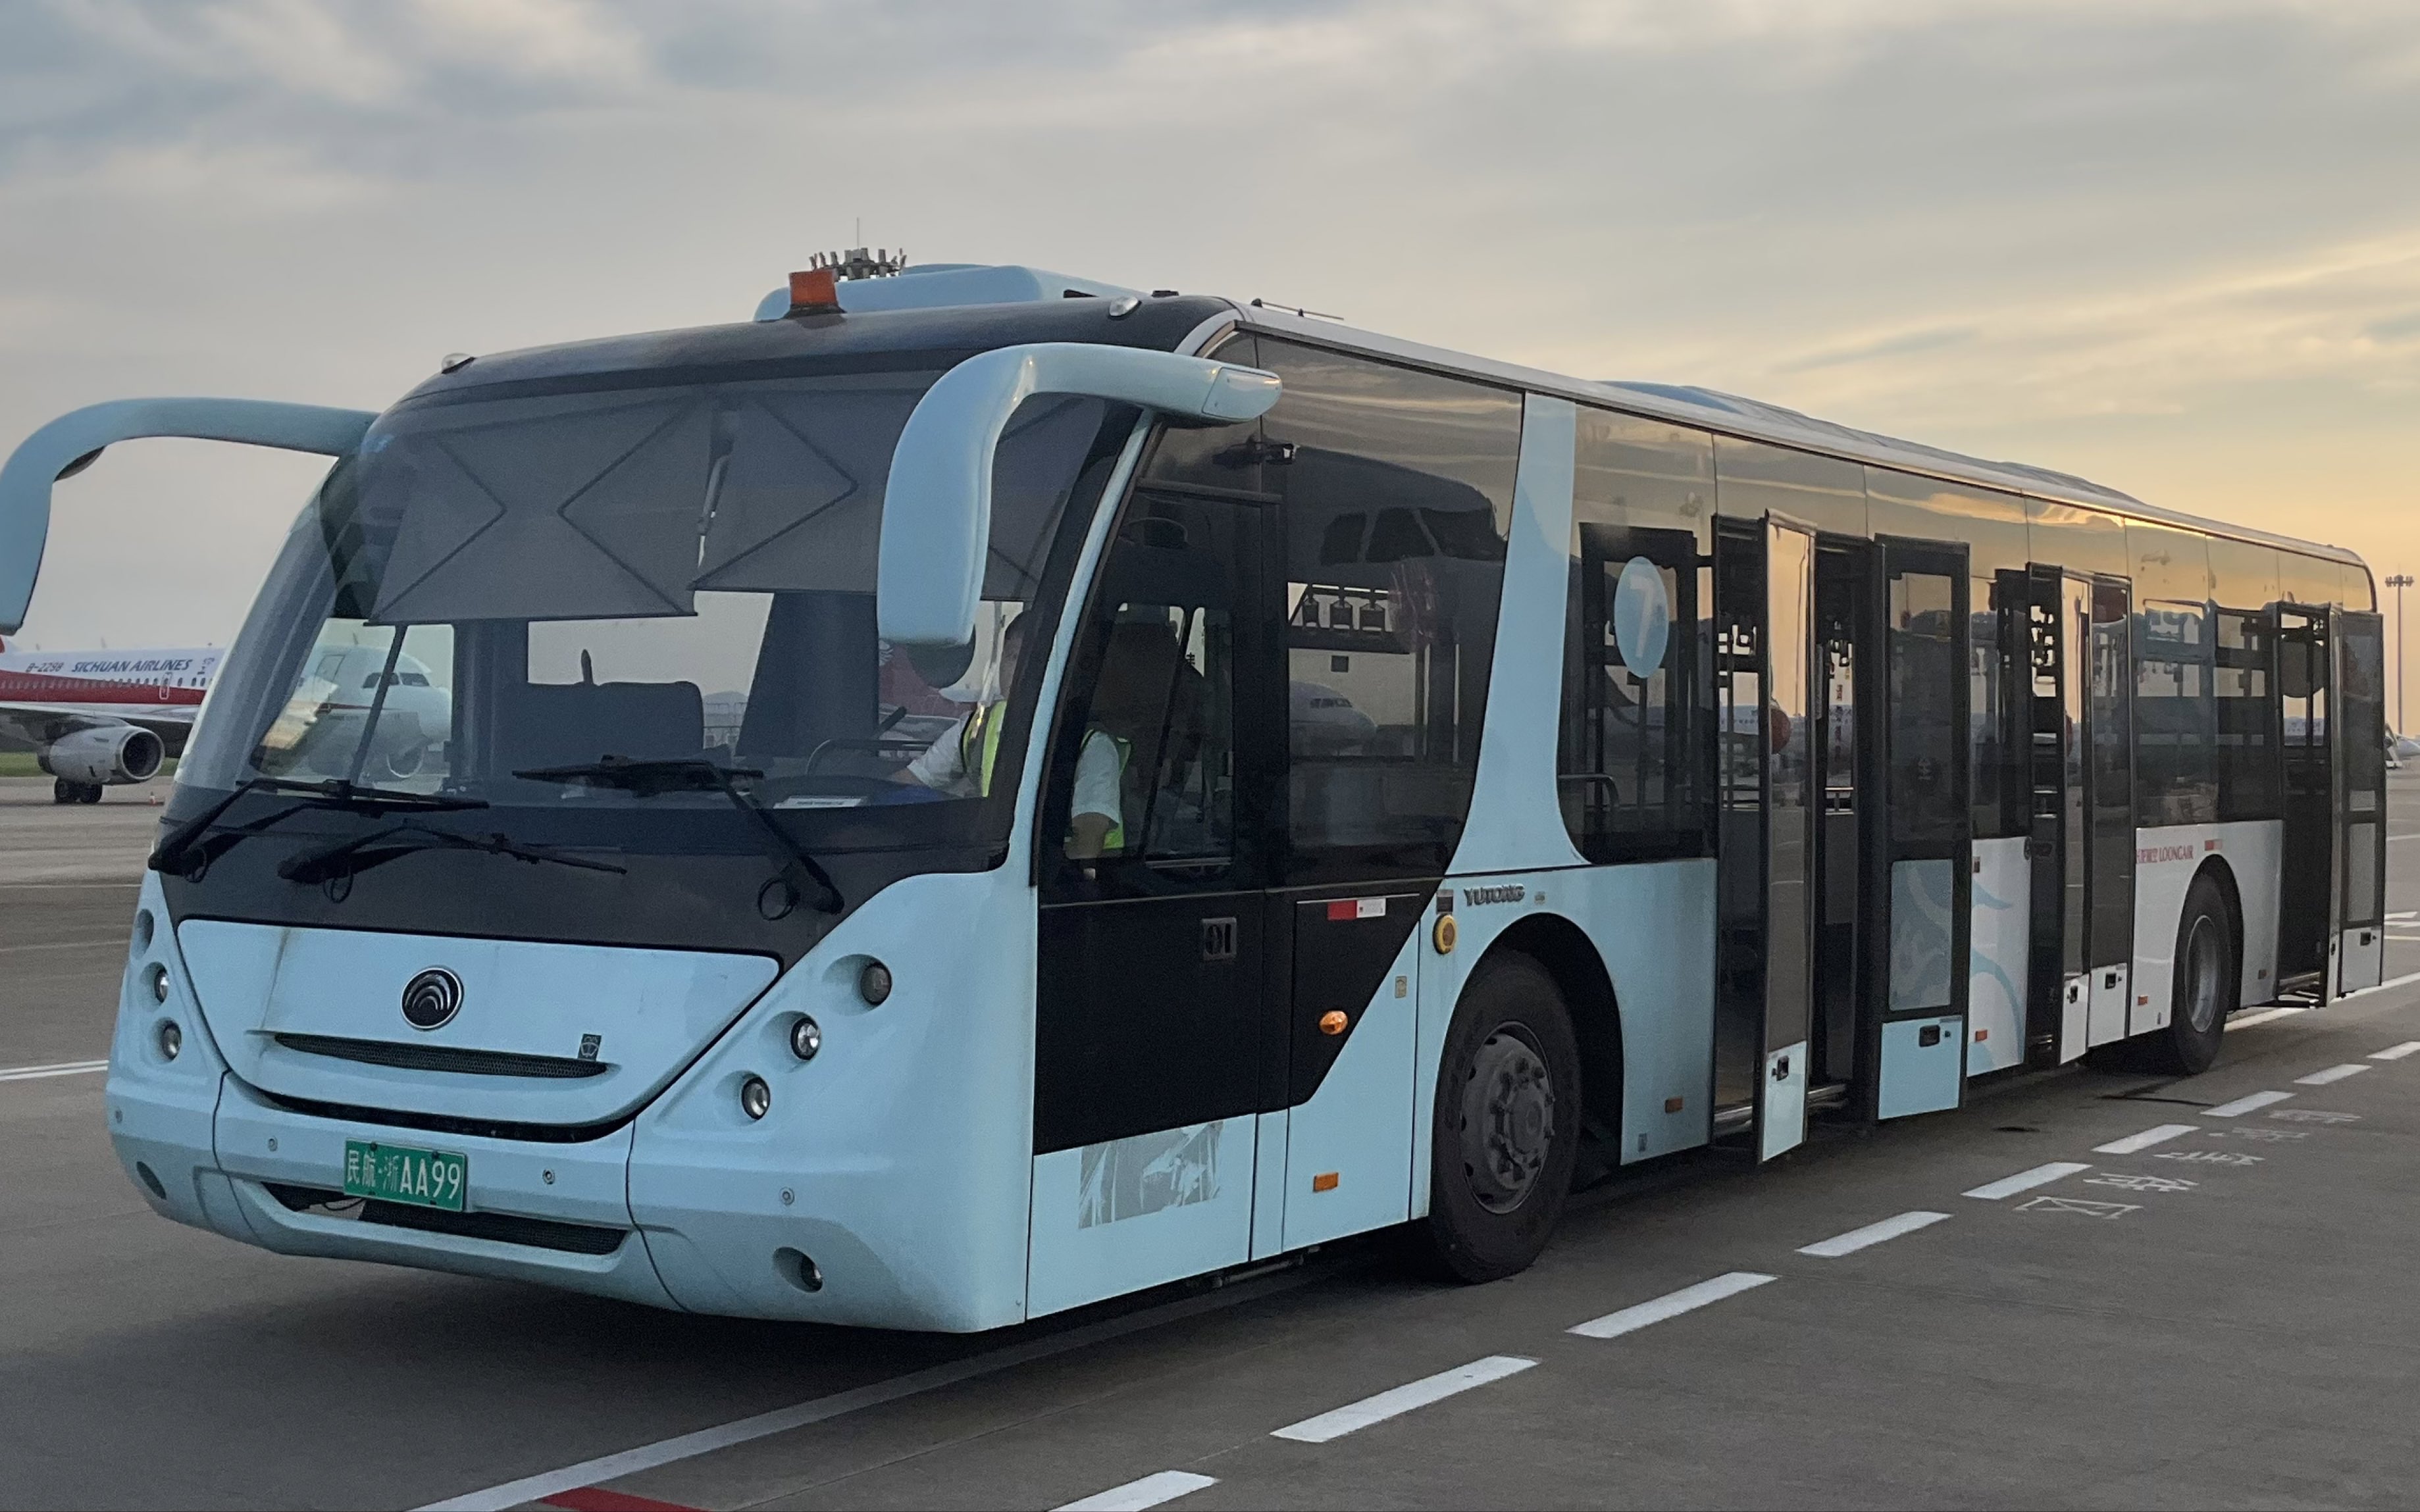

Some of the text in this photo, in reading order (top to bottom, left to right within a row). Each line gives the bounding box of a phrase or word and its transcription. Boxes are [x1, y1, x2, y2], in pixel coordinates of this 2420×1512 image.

[71, 661, 132, 672] SICHUAN
[130, 659, 193, 671] AIRLINES
[1463, 884, 1525, 907] YUTONG
